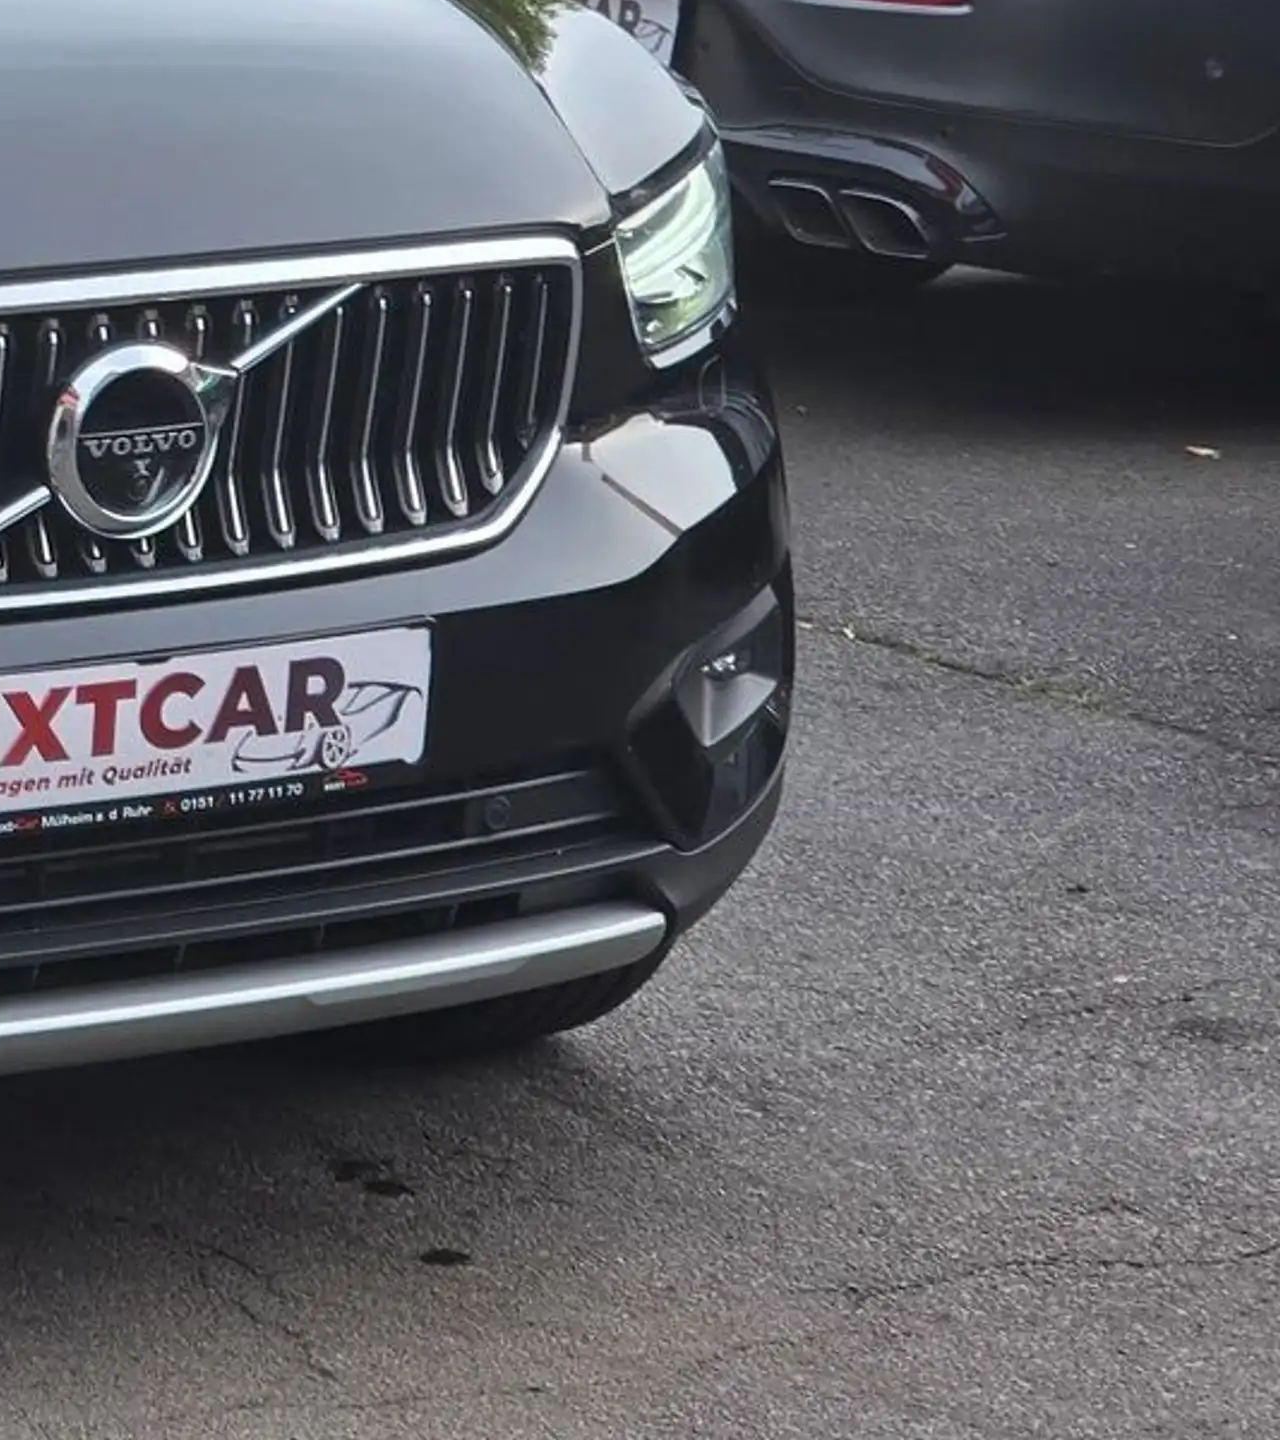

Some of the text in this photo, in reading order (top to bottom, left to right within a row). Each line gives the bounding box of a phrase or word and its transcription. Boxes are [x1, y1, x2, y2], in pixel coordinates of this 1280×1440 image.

[83, 429, 197, 458] VOLVO
[57, 770, 94, 790] mit
[101, 758, 192, 785] Qualität
